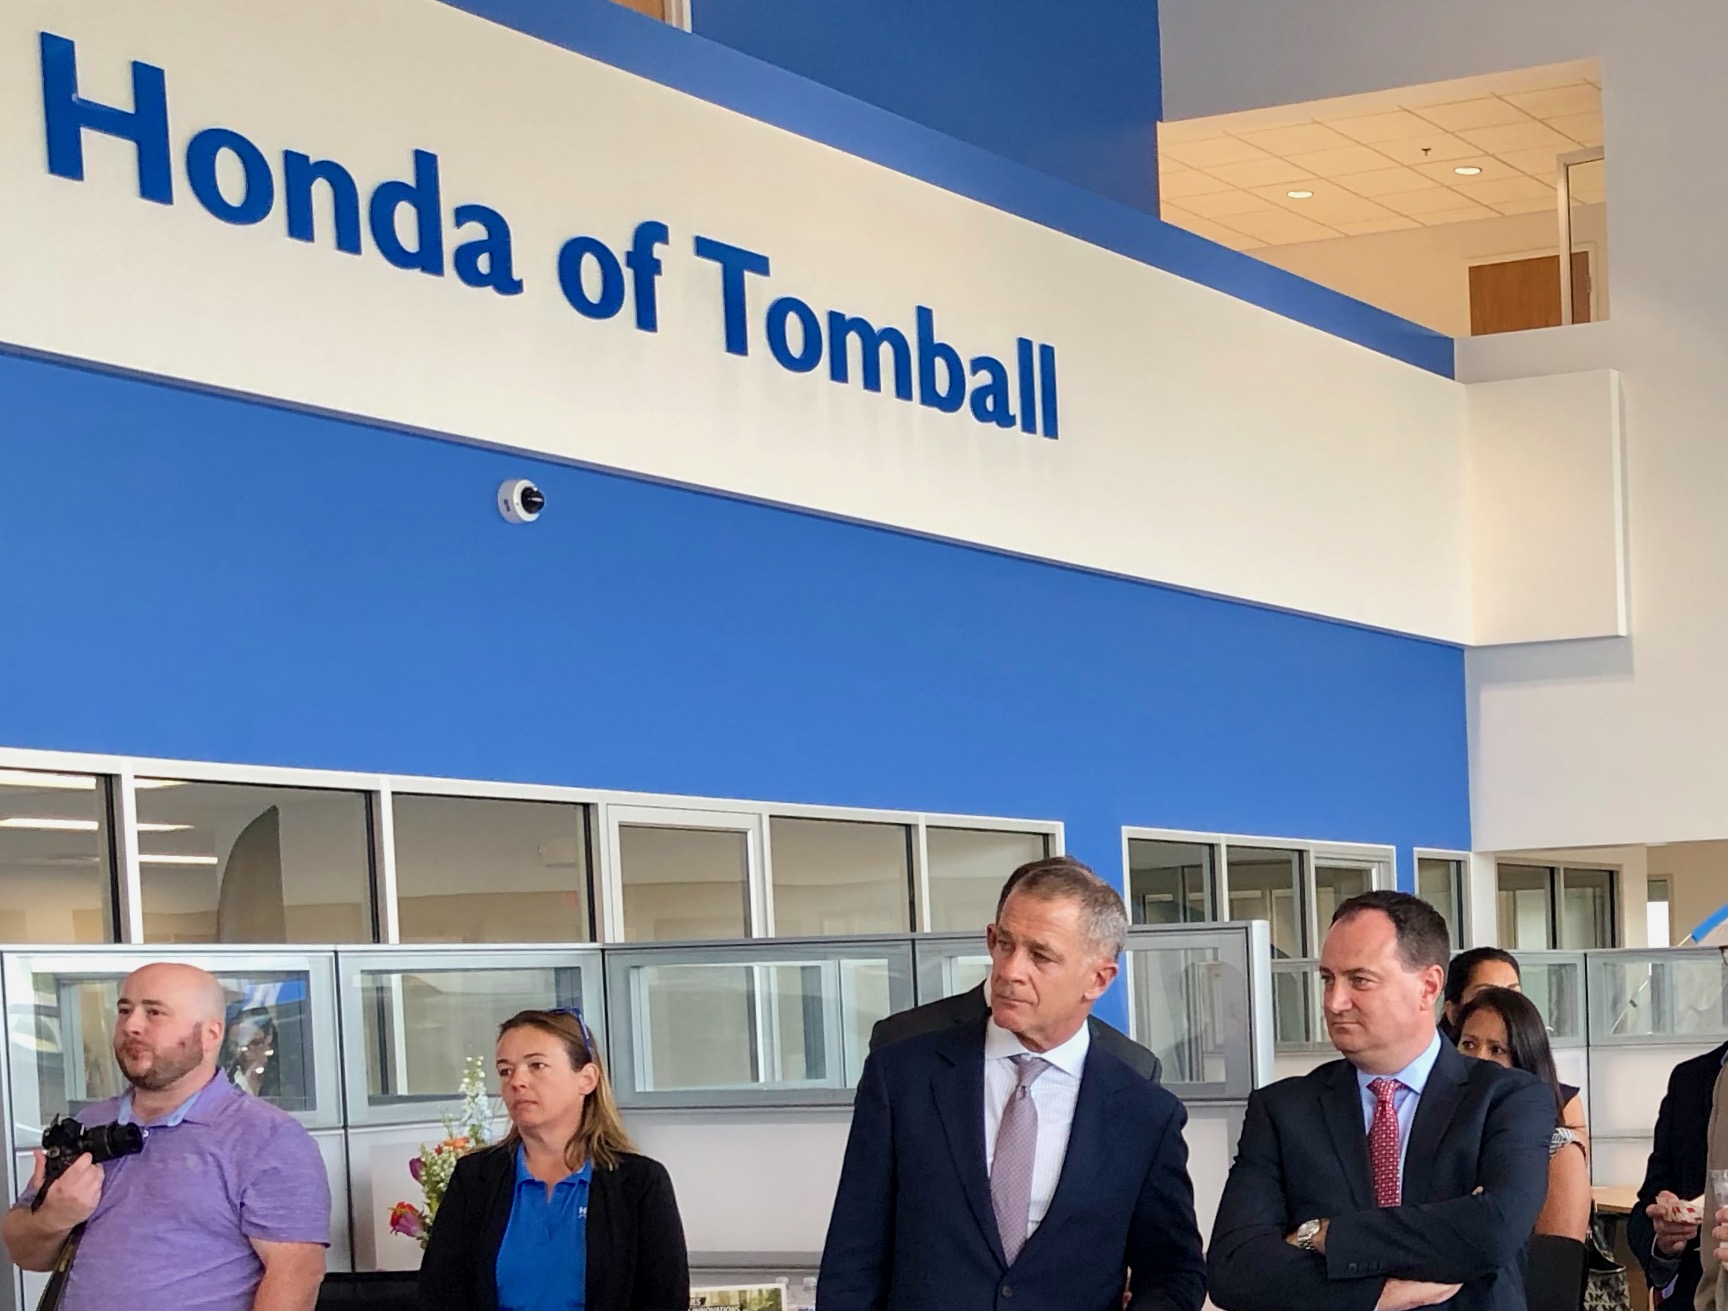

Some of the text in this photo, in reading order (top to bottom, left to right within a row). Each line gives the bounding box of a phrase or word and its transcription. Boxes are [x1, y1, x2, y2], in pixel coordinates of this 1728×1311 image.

[40, 31, 1059, 440] Honda of Tomball
